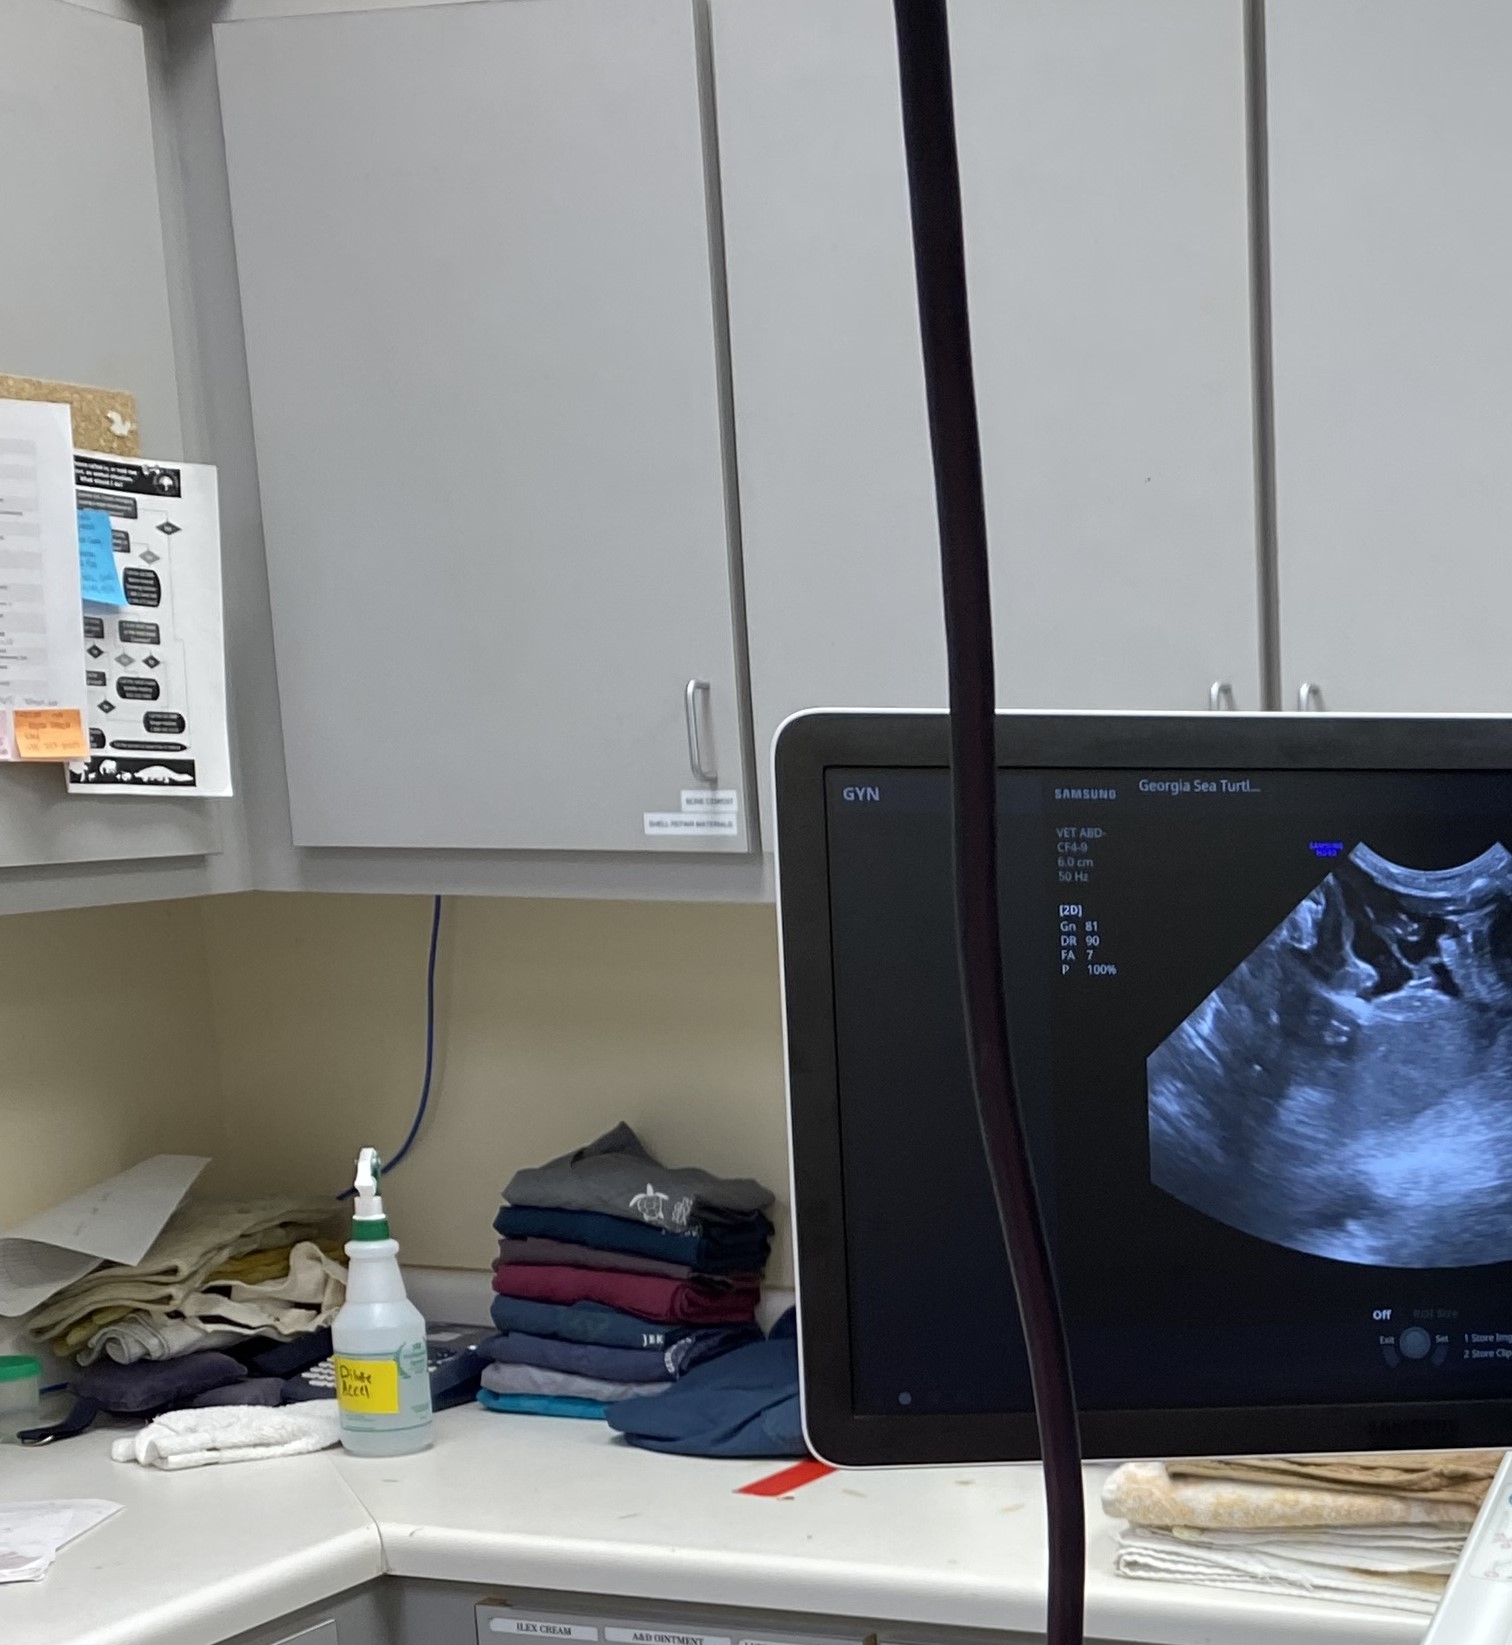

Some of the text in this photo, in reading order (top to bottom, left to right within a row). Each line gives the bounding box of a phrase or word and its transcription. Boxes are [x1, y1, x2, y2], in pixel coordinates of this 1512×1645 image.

[1138, 779, 1191, 796] Georgia
[1193, 780, 1217, 793] Sea
[843, 786, 880, 801] GYN
[1055, 788, 1117, 800] SAMSUNG
[1056, 827, 1077, 838] VET
[1057, 856, 1094, 868] 6.0 cm
[1058, 871, 1089, 882] 50 Hz
[1059, 904, 1082, 918] [2D]
[1060, 920, 1098, 932] Gn 81
[1060, 935, 1100, 946] DR 90
[1061, 949, 1094, 960] FA 7
[1061, 964, 1117, 975] P 100%
[1372, 1309, 1392, 1320] Off
[1379, 1336, 1395, 1345] Exit
[1435, 1334, 1449, 1343] Set
[1471, 1333, 1495, 1343] Store
[1471, 1349, 1495, 1359] Store
[1496, 1349, 1512, 1360] Clip
[516, 1622, 572, 1636] ILEX CREAM
[631, 1632, 652, 1642] A&D
